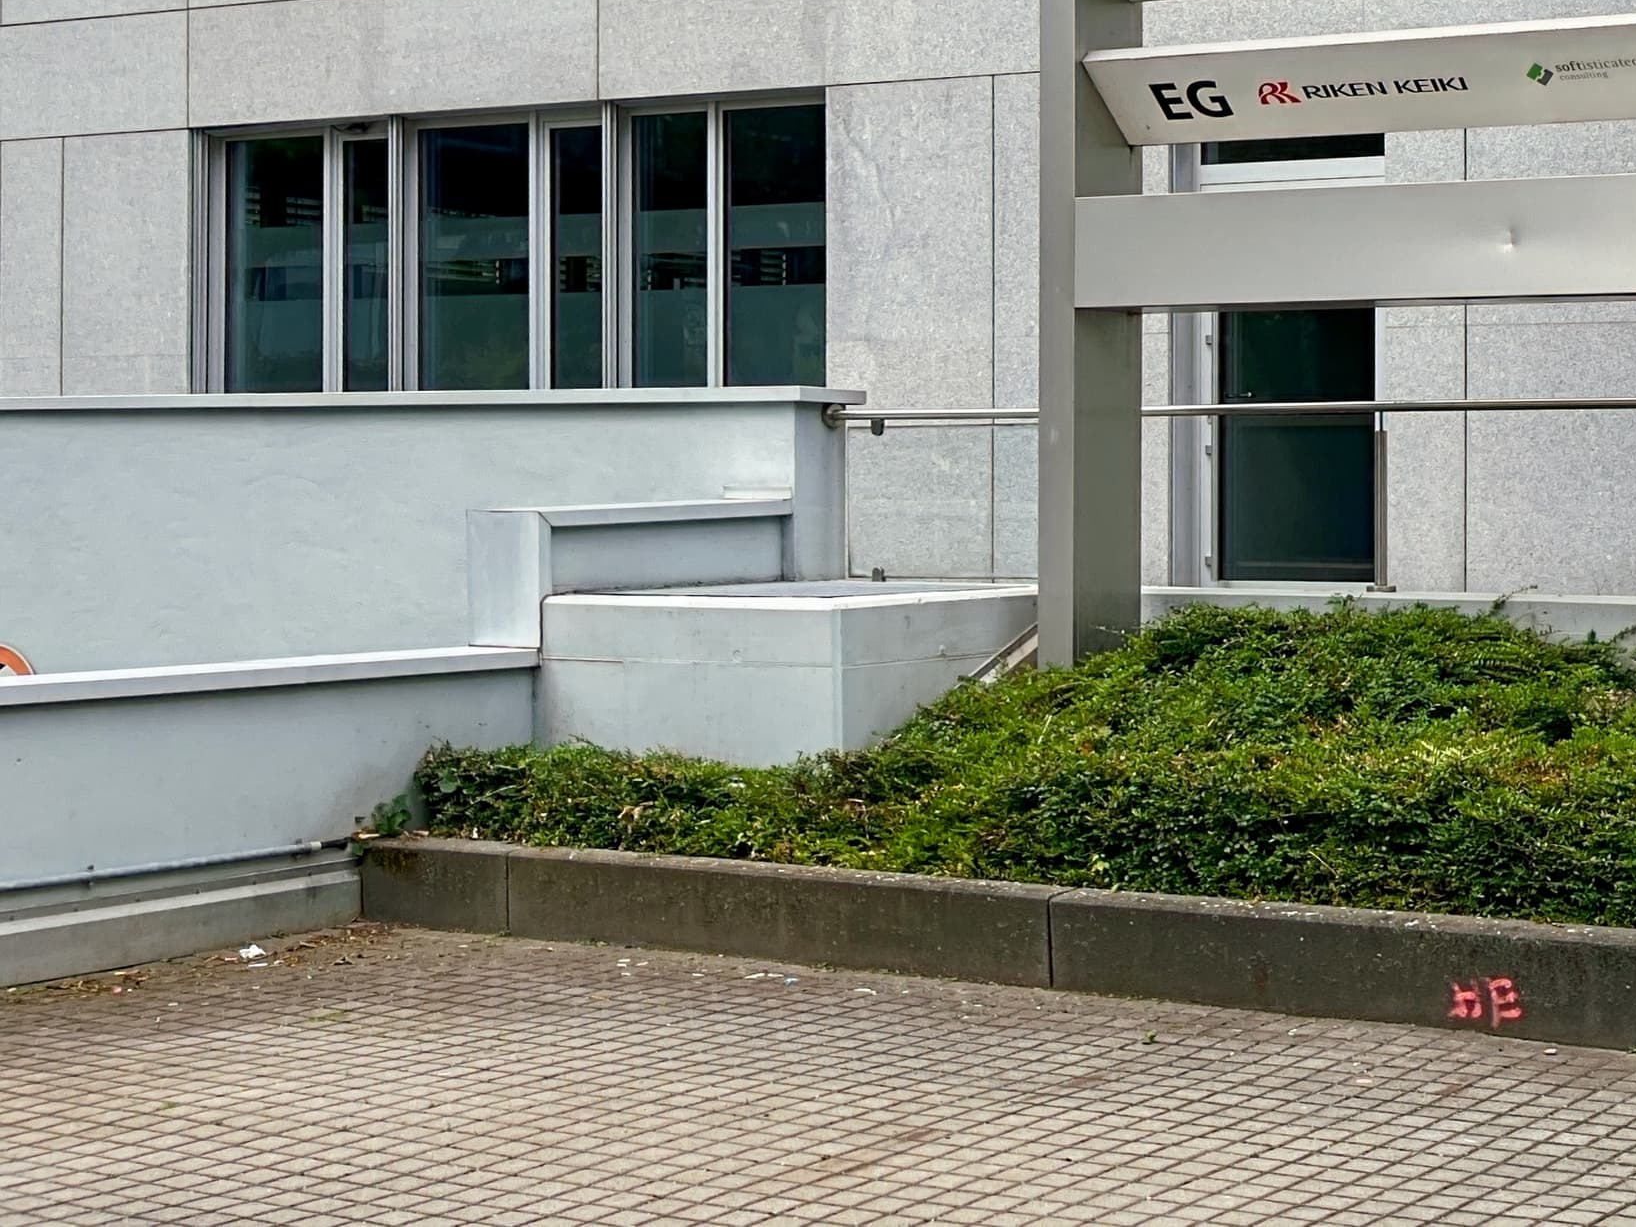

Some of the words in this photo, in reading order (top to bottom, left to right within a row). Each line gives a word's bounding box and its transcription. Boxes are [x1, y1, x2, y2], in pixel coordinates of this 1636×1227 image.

[1148, 80, 1234, 121] EG
[1301, 81, 1387, 99] RIKEN
[1393, 77, 1469, 94] KEIKI
